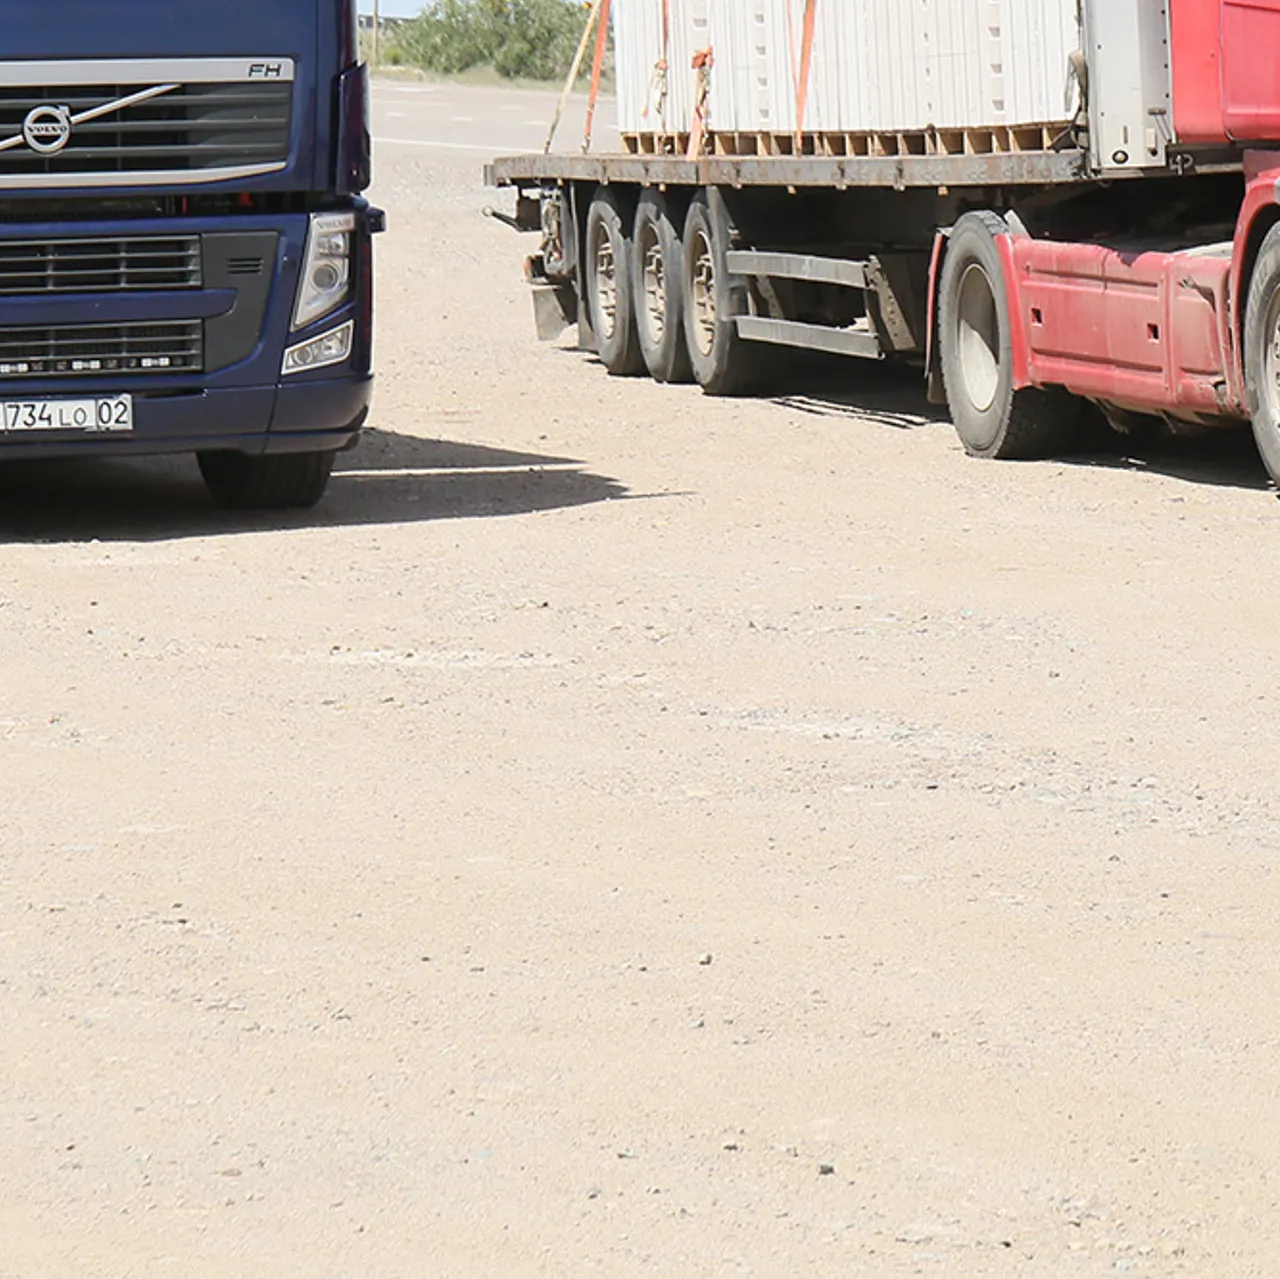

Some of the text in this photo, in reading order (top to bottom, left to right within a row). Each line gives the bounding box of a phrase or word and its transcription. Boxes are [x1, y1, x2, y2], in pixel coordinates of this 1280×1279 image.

[249, 63, 282, 77] FH
[27, 125, 67, 133] VOLVO
[98, 401, 128, 424] 02
